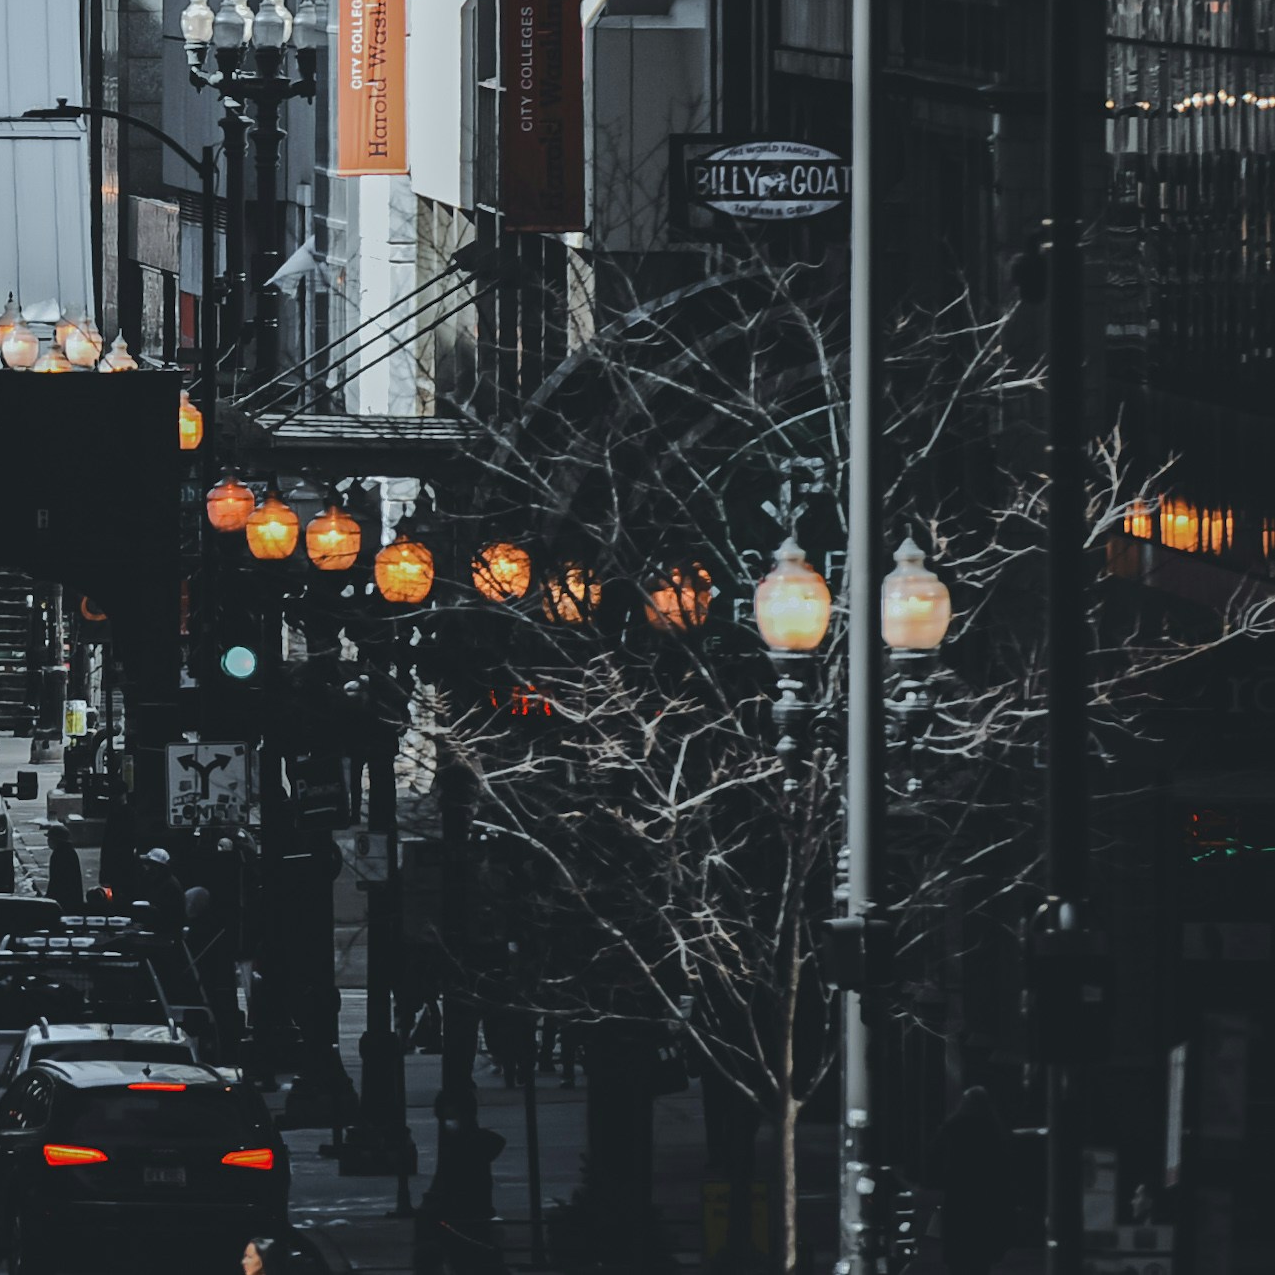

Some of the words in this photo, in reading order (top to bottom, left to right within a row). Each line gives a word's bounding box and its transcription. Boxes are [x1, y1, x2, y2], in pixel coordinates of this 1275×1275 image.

[520, 6, 533, 90] COLLEGES
[351, 58, 364, 90] CITY
[367, 77, 388, 158] Harold
[520, 96, 533, 132] CITY
[694, 165, 761, 196] BILLY
[791, 165, 852, 196] GOAT
